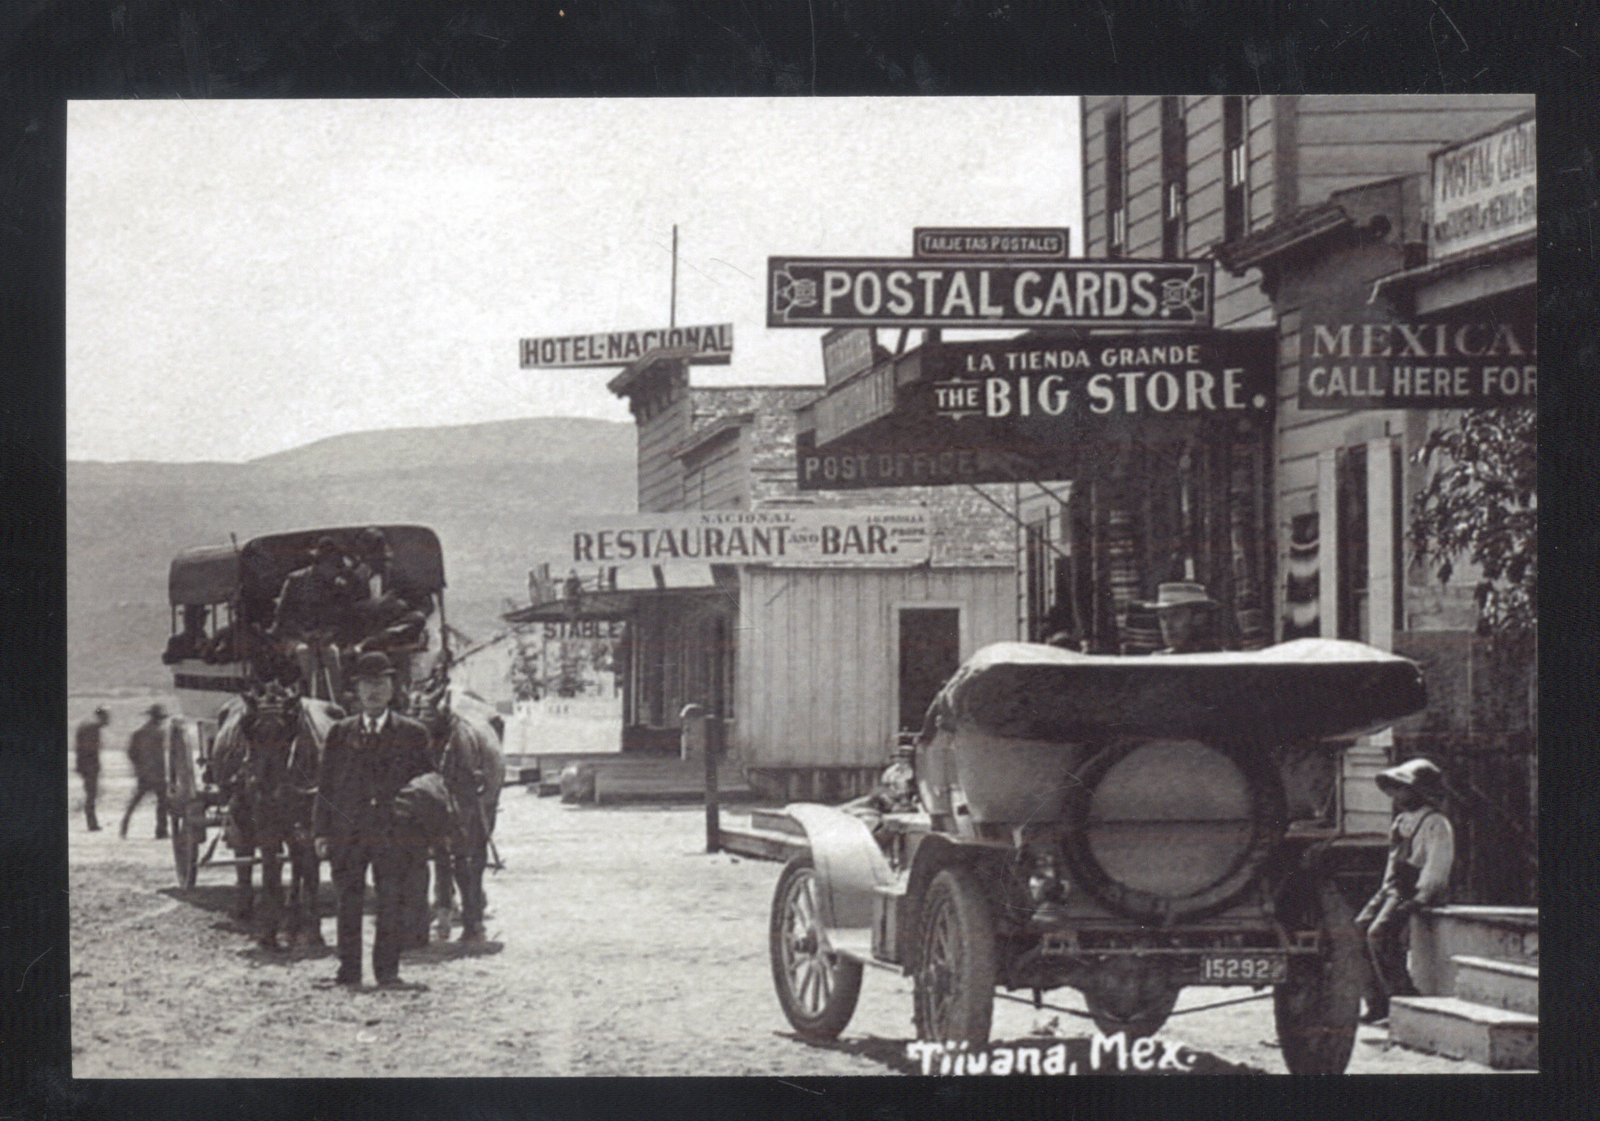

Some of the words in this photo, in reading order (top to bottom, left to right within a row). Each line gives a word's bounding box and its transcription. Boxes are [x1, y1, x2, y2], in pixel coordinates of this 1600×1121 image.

[990, 235, 1059, 250] POSTALES
[822, 270, 1004, 316] POSTAL
[1312, 323, 1537, 358] MEXICA
[966, 354, 996, 373] LA
[1006, 350, 1091, 371] TIENDA
[1101, 345, 1200, 368] GRANDE
[935, 387, 980, 408] THE
[985, 374, 1071, 418] BIG
[1087, 367, 1266, 414] STORE.
[1307, 366, 1386, 397] CALL
[1393, 366, 1471, 396] HERE
[804, 453, 871, 481] POST
[573, 526, 791, 562] RESTAURANT
[821, 524, 899, 555] BAR.
[543, 620, 620, 639] STABLE
